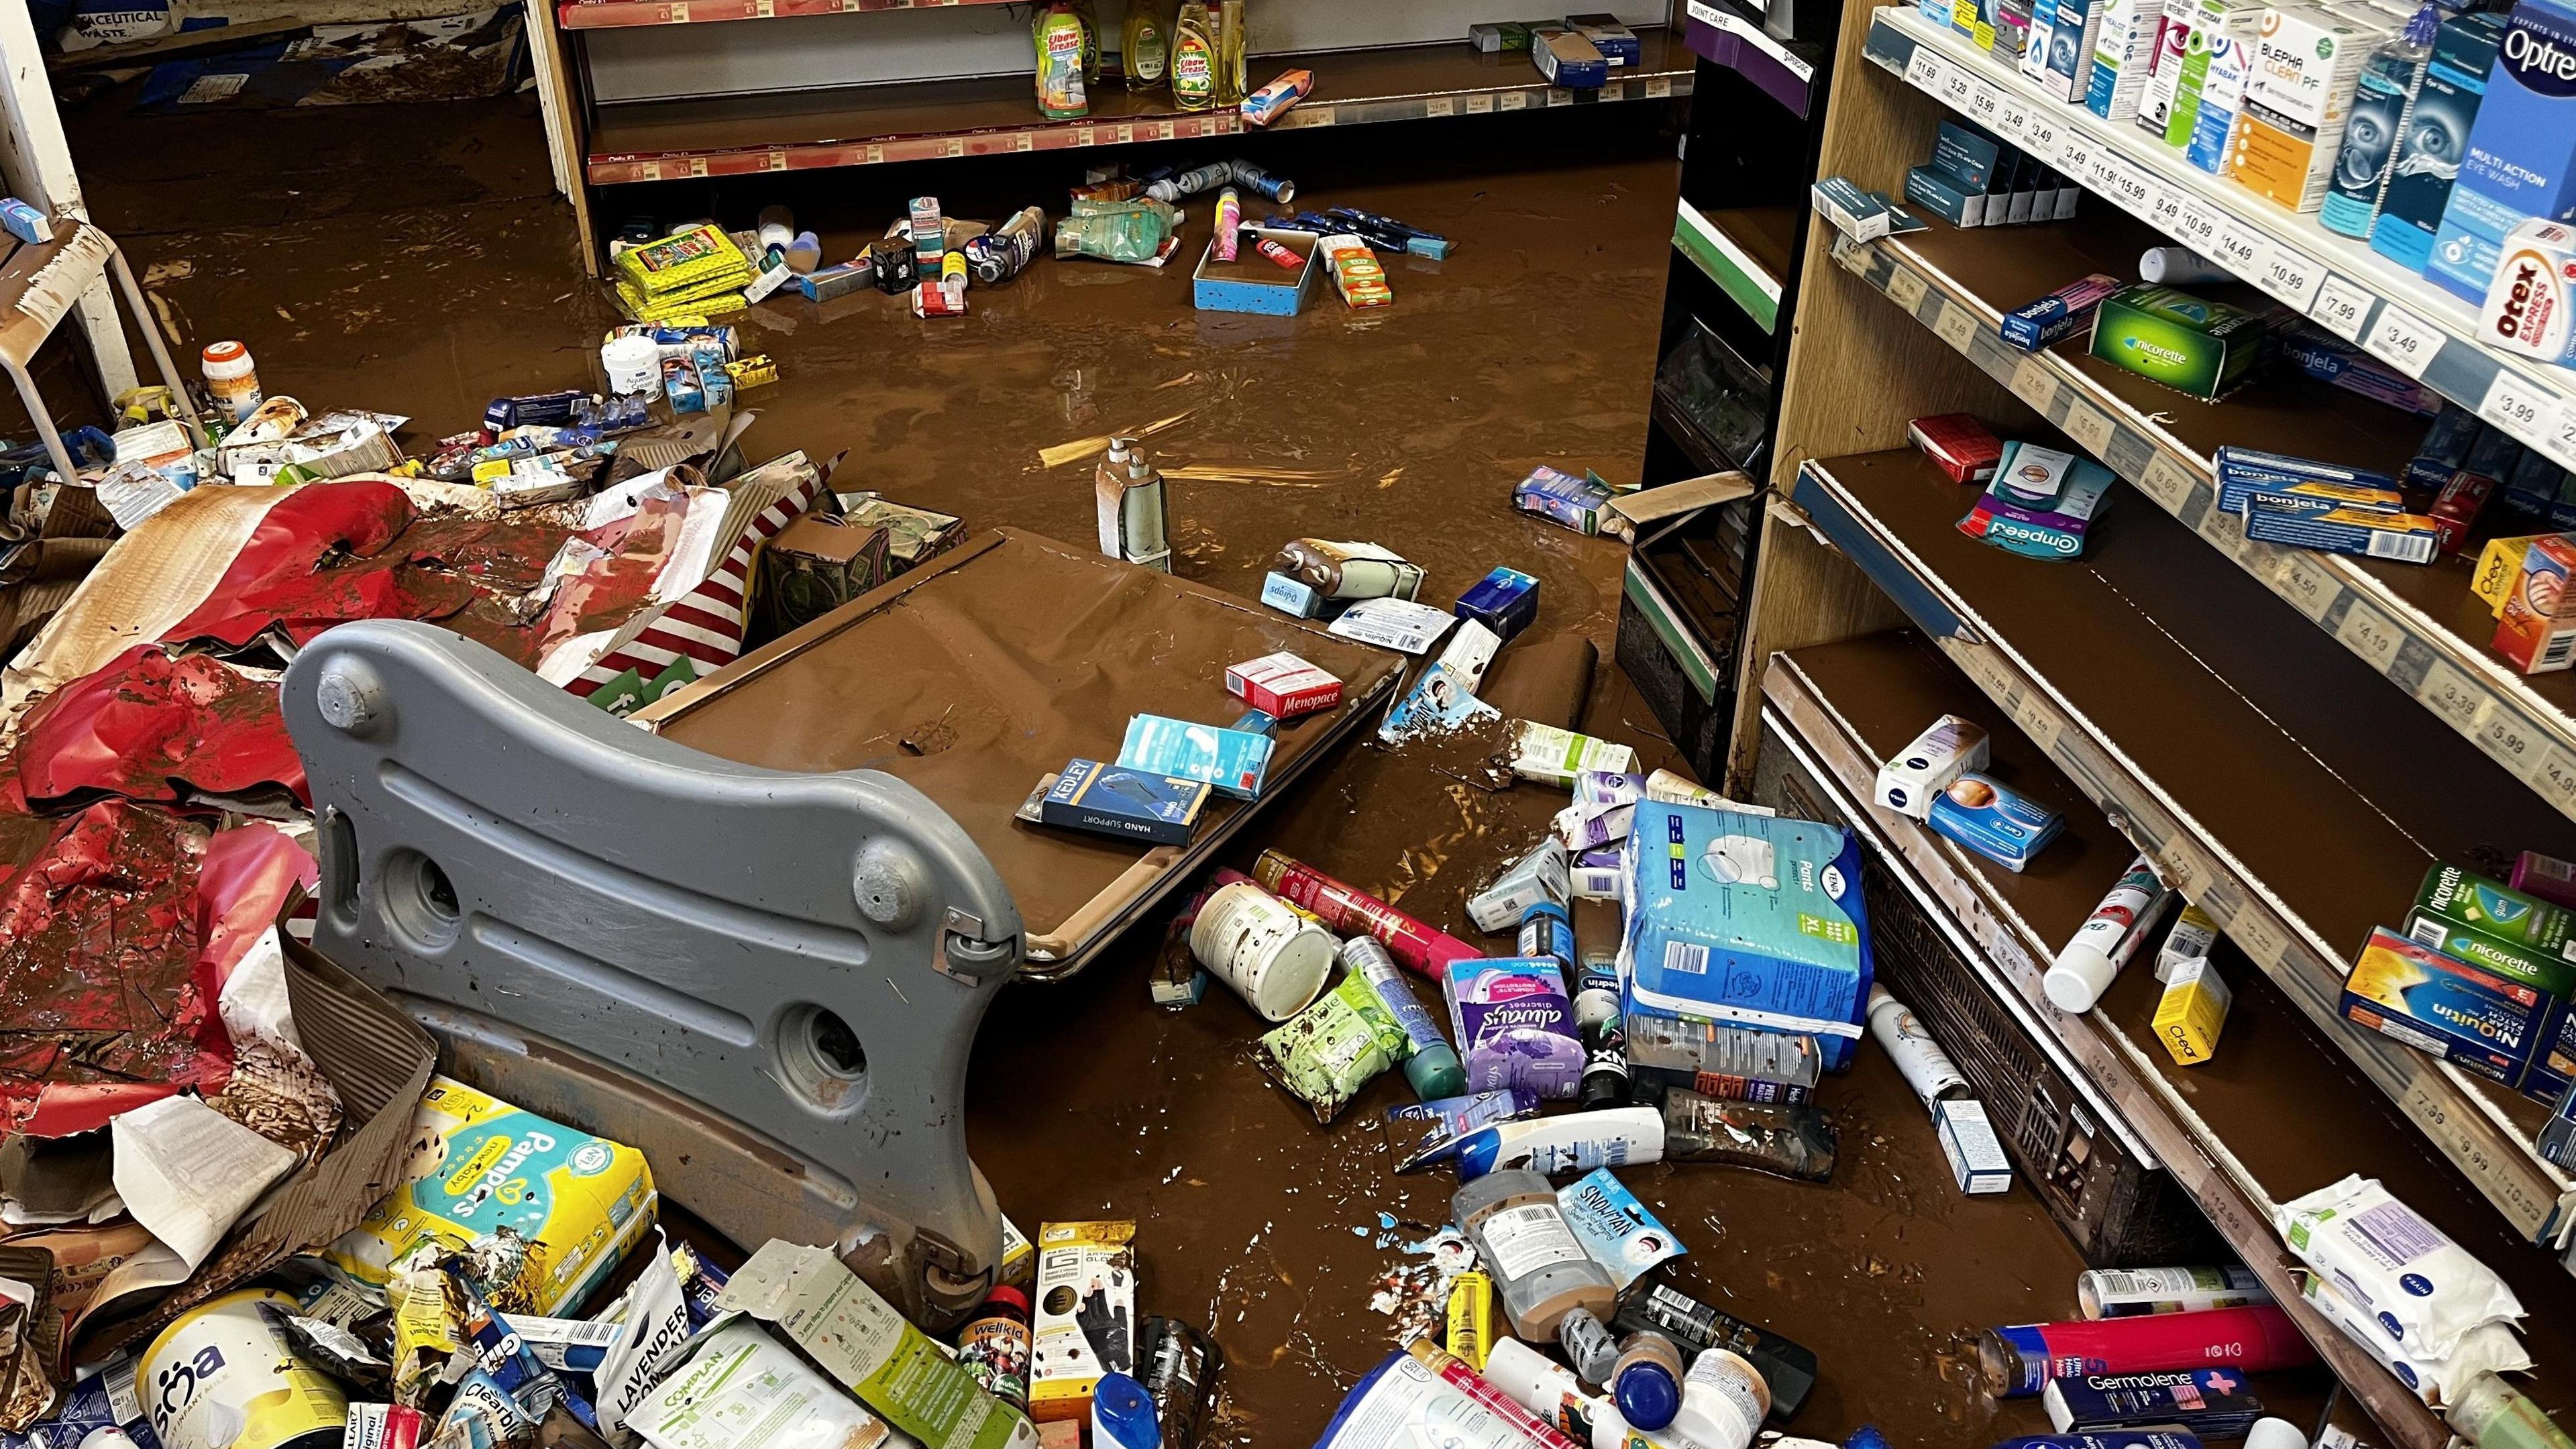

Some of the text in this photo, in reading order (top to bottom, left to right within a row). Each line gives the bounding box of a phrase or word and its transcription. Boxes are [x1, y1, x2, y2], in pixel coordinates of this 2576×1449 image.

[1691, 5, 1729, 28] JOINT CARE
[2514, 16, 2547, 36] EXPERTS
[1048, 31, 1078, 43] Elbow
[1049, 40, 1079, 52] Grease
[1180, 59, 1206, 67] Elbow
[2260, 42, 2304, 70] BLEPHA
[1915, 58, 1937, 79] £11.69
[1950, 76, 1968, 95] £5.29
[2301, 75, 2320, 91] PF
[2004, 109, 2023, 127] £3.49
[2032, 123, 2052, 143] £3.49
[2065, 144, 2086, 165] £3.49
[2465, 158, 2522, 191] EYE WASH
[2470, 147, 2547, 189] MULTI ACTION
[2118, 176, 2145, 200] £15.99
[2182, 211, 2213, 237] £10.99
[2221, 233, 2253, 260] £14.49
[2269, 260, 2304, 290] £10.99
[2016, 298, 2059, 319] bonjela
[2326, 294, 2357, 321] £7.99
[2496, 262, 2538, 339] Otex
[2519, 281, 2548, 343] EXPRESS
[2040, 315, 2074, 340] bonjela
[2387, 326, 2418, 354] £3.49
[2136, 338, 2188, 366] nicorette
[2282, 340, 2341, 375] bonjela
[626, 372, 656, 384] Aqueous
[632, 379, 654, 391] Cream
[2500, 394, 2535, 423] £3.99
[2226, 467, 2300, 484] bonjela
[2411, 467, 2449, 483] bonjela
[2255, 493, 2331, 511] bonjela
[2503, 494, 2542, 516] bonjela
[1990, 521, 2079, 553] Compeed
[2291, 566, 2318, 596] £4.50
[1283, 691, 1339, 714] Menopace
[2490, 720, 2526, 755] £5.99
[1051, 761, 1091, 800] KEDLEY
[1888, 792, 1907, 804] NIVEA
[1082, 815, 1151, 833] HAND SUPPORT
[2003, 824, 2023, 838] Care
[1799, 859, 1815, 893] Pants
[1828, 871, 1839, 893] TENA
[2430, 865, 2462, 911] nicorette
[2495, 898, 2508, 918] gum
[1806, 916, 1821, 934] XL
[2470, 939, 2539, 976] nicorette
[1587, 978, 1620, 992] Hedrin
[1483, 1005, 1562, 1028] always
[2432, 1003, 2520, 1049] NiQuitin
[2488, 1011, 2524, 1031] PATCH
[2489, 1019, 2522, 1036] CLEAR
[452, 1130, 556, 1219] Pampers
[1569, 1198, 1585, 1215] Super
[1579, 1185, 1635, 1236] SNOWMAN
[1568, 1208, 1599, 1238] Sheet Mask
[2406, 1275, 2430, 1295] NIVEA
[974, 1322, 1024, 1338] wellkid
[616, 1304, 686, 1414] LAVENDER
[663, 1350, 724, 1409] COMPLAN
[2088, 1371, 2193, 1391] Germolene
[176, 1395, 203, 1430] INFANT
